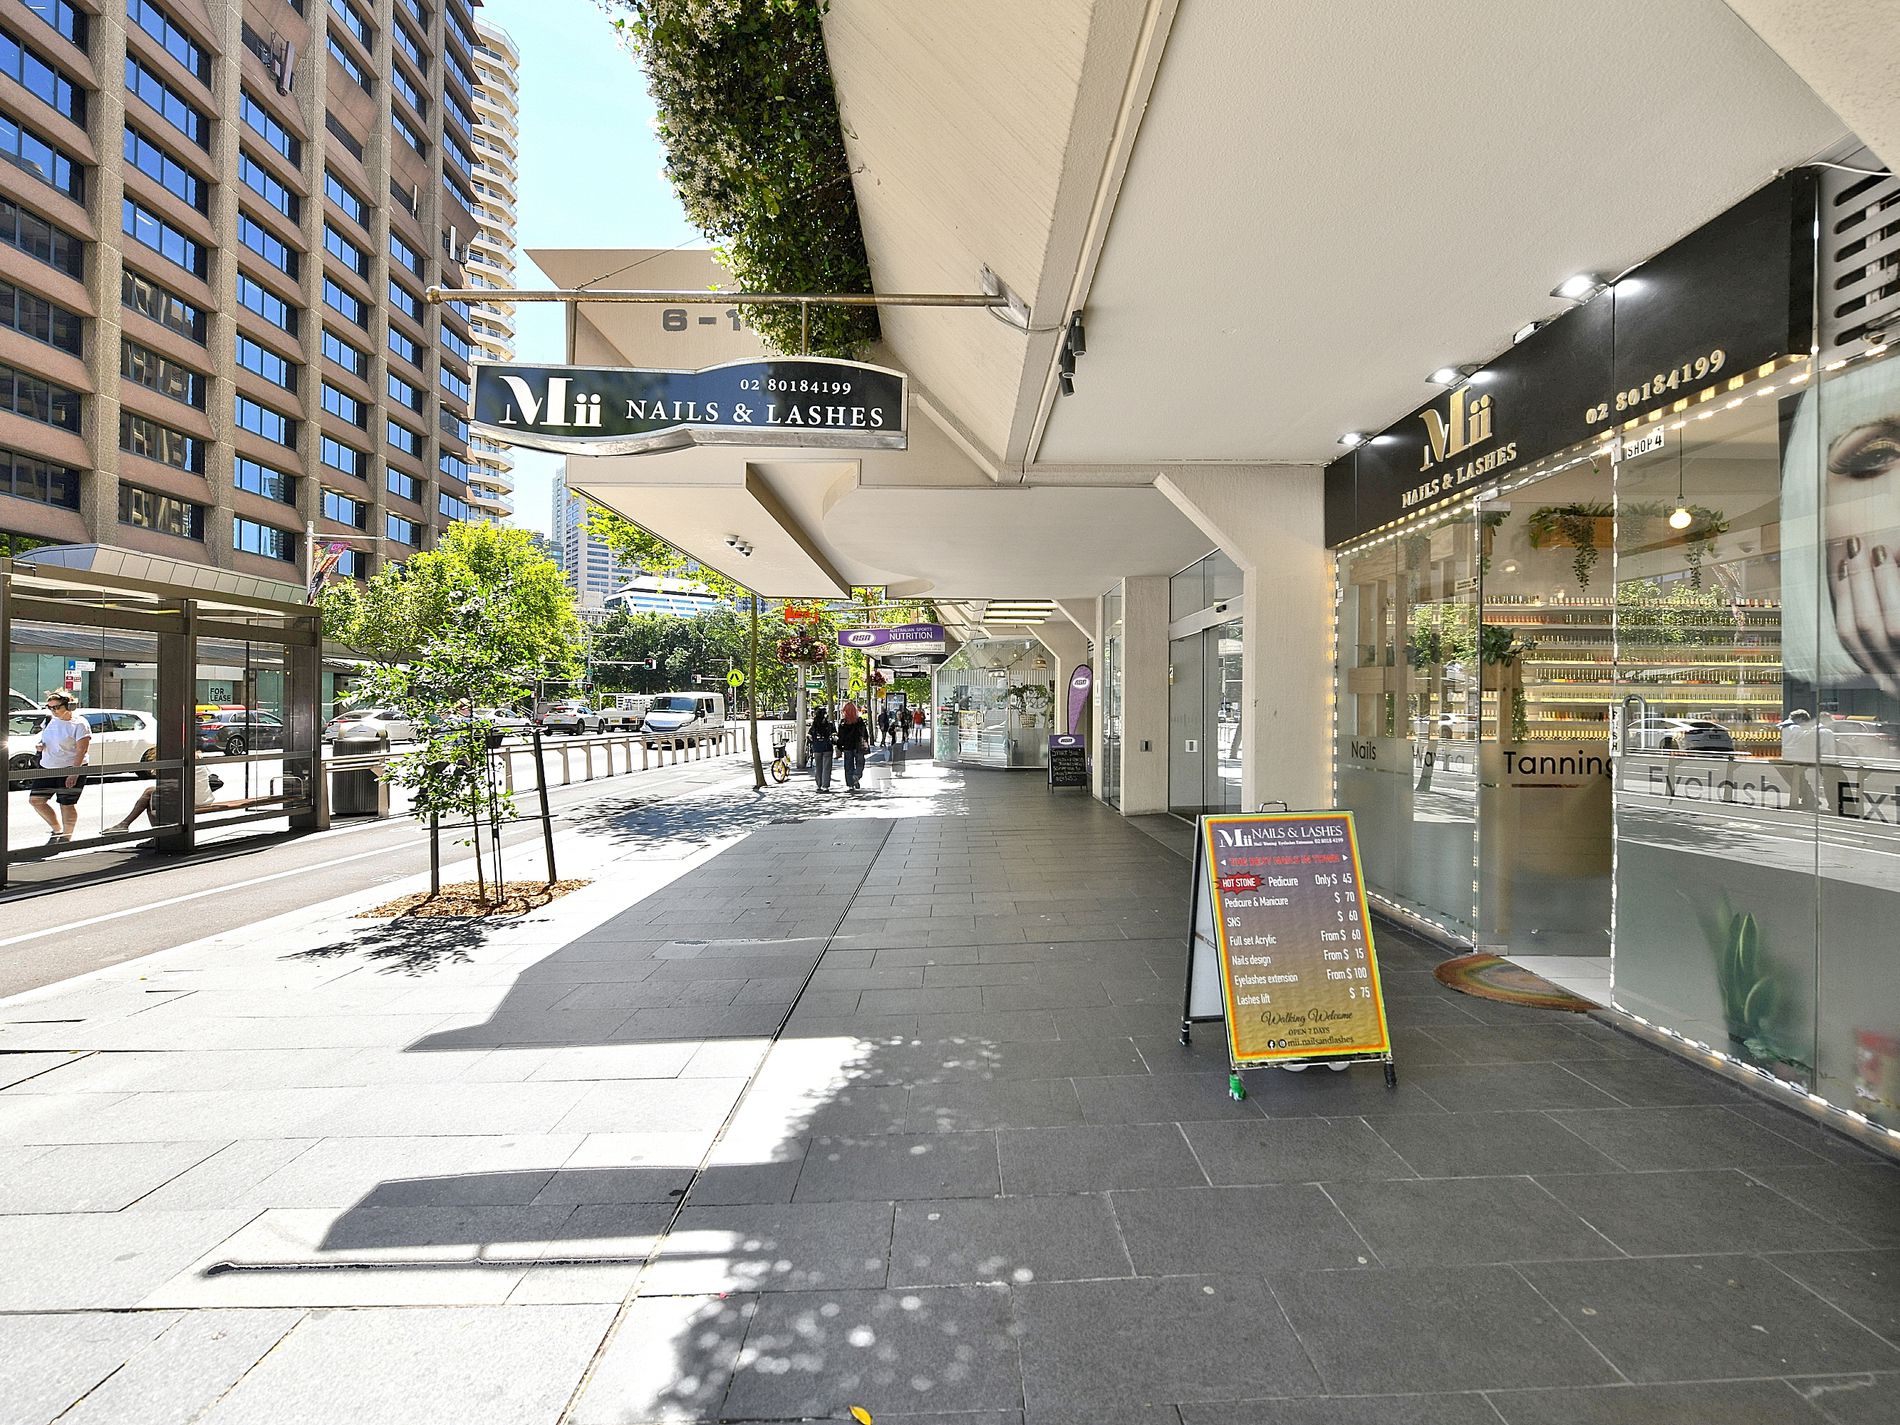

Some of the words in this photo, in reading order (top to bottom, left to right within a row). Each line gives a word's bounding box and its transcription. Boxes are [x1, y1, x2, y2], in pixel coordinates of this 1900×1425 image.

[740, 379, 760, 391] 02
[767, 378, 852, 395] 80184199
[1586, 403, 1609, 424] 02
[1616, 349, 1726, 411] 80184199
[498, 375, 602, 427] Mii
[625, 400, 719, 422] NAILS
[732, 403, 754, 423] &
[766, 404, 884, 427] LASHES
[1418, 385, 1493, 472] Mii
[1627, 438, 1652, 457] SHOP
[1655, 435, 1662, 446] 4
[1401, 478, 1440, 508] NAILS
[1442, 473, 1454, 490] &
[1456, 442, 1517, 484] LASHES
[889, 631, 933, 641] NUTRITION
[210, 687, 225, 695] FOR
[210, 694, 231, 702] LEASE
[1351, 741, 1377, 760] Nails
[1649, 766, 1782, 809] Eyelash
[1217, 828, 1253, 848] Mii
[1252, 828, 1285, 839] NAILS
[1287, 827, 1299, 838] &
[1301, 825, 1343, 838] LASHES
[1222, 878, 1234, 888] HOT
[1235, 877, 1256, 887] STONE
[1268, 875, 1299, 887] Pedicure
[1315, 873, 1331, 887] Only
[1342, 872, 1352, 884] 45
[1224, 897, 1252, 908] Pedicure
[1253, 896, 1259, 907] &
[1259, 895, 1289, 907] Manicure
[1345, 891, 1355, 902] 70
[1226, 916, 1241, 928] SNS
[1348, 910, 1358, 921] 60
[1229, 935, 1243, 946] Full
[1243, 935, 1254, 946] set
[1254, 934, 1277, 947] Acrylic
[1320, 930, 1340, 941] From
[1351, 928, 1361, 940] 60
[1231, 955, 1249, 966] Nails
[1249, 954, 1272, 967] design
[1323, 949, 1343, 961] From
[1355, 947, 1364, 959] 15
[1234, 974, 1267, 988] Eyelashes
[1267, 972, 1299, 984] extension
[1326, 968, 1345, 980] From
[1353, 967, 1368, 979] 100
[1236, 994, 1260, 1006] Lashes
[1260, 992, 1271, 1004] lift
[1360, 986, 1371, 998] 75
[1261, 1010, 1306, 1027] Walking
[1307, 1008, 1353, 1023] Welcome
[1288, 1028, 1306, 1036] OPEN
[1313, 1026, 1330, 1034] DAYS
